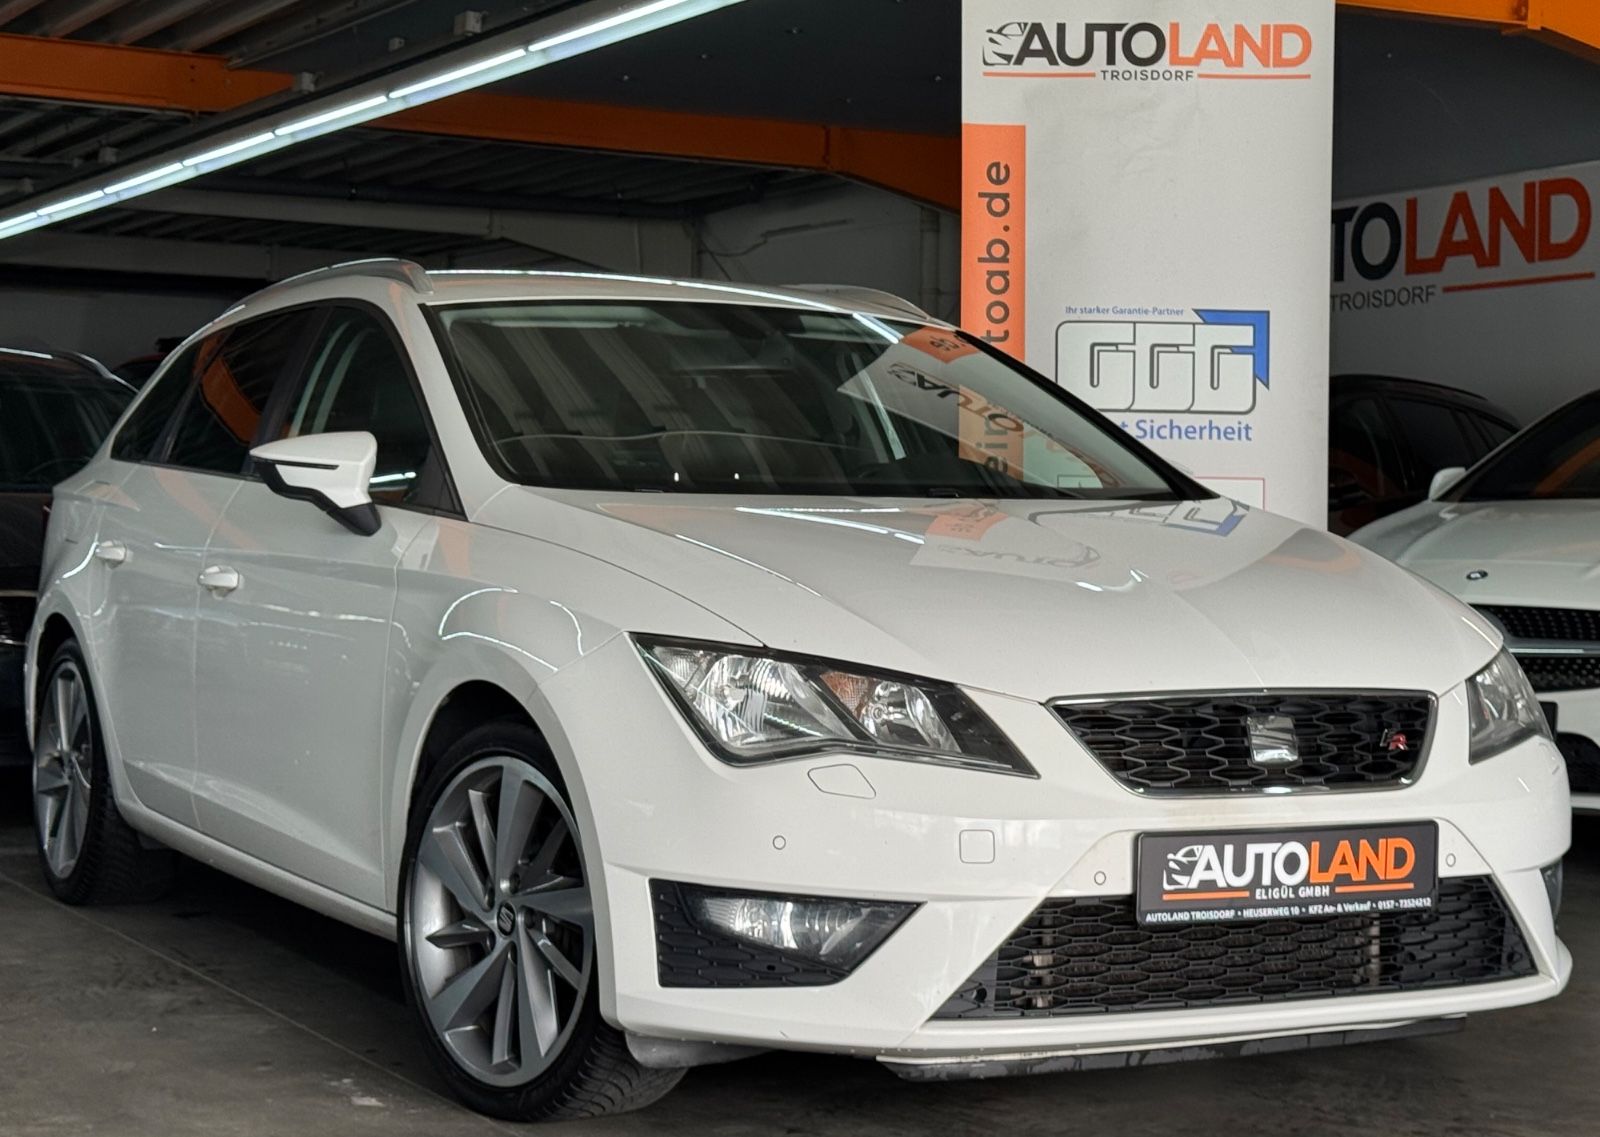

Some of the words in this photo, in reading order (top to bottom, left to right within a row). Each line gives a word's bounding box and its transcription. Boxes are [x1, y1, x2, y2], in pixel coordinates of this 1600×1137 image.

[1012, 21, 1312, 68] AUTOLAND
[1100, 69, 1194, 82] TROISDORF
[1331, 284, 1437, 312] TROISDORF
[1065, 305, 1079, 315] Ihr
[1080, 305, 1110, 315] starker
[1135, 418, 1253, 442] Sicherheit
[1186, 837, 1416, 889] AUTOLAND
[1255, 886, 1295, 900] ELIGÜL
[1298, 885, 1330, 898] GMBH
[1145, 910, 1190, 923] AUTOLAND
[1190, 908, 1235, 921] TROISDORF
[1243, 906, 1290, 919] HEUSERWEG
[1291, 906, 1300, 916] 10
[1308, 904, 1324, 915] KFZ
[1342, 900, 1371, 912] Verkauf
